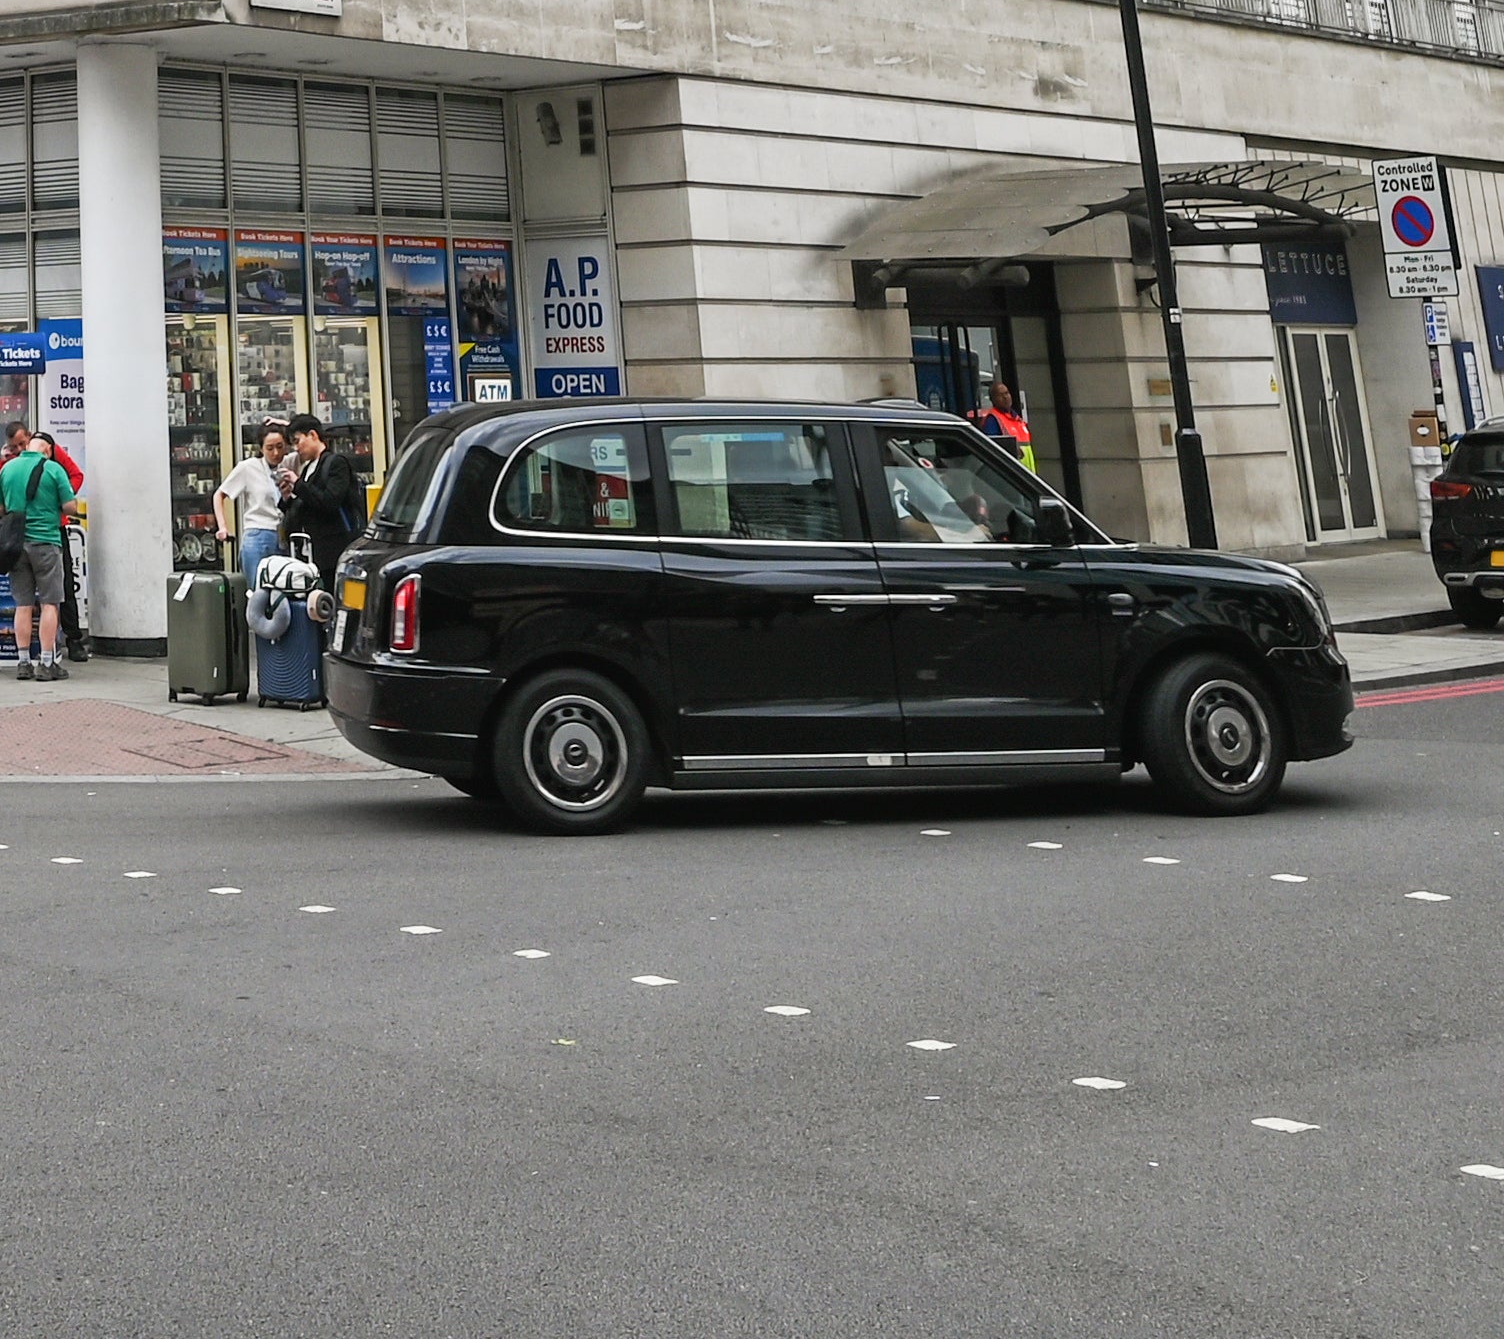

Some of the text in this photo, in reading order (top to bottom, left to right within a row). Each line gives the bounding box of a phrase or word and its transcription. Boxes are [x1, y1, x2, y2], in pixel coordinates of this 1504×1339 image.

[1377, 161, 1433, 176] Controlled
[1381, 176, 1433, 193] ZONE W
[279, 249, 298, 259] Tours
[392, 253, 437, 265] Attractions
[1266, 251, 1346, 275] LETTUCE
[544, 256, 599, 298] A.P.
[1406, 276, 1438, 284] Saturday
[543, 302, 604, 330] FOOD
[474, 346, 501, 354] Free Cash
[545, 336, 605, 354] EXPRESS
[2, 347, 41, 359] Tickets
[471, 355, 505, 363] Withdrawals
[551, 373, 605, 394] OPEN
[479, 385, 508, 400] ATM
[600, 481, 610, 499] &
